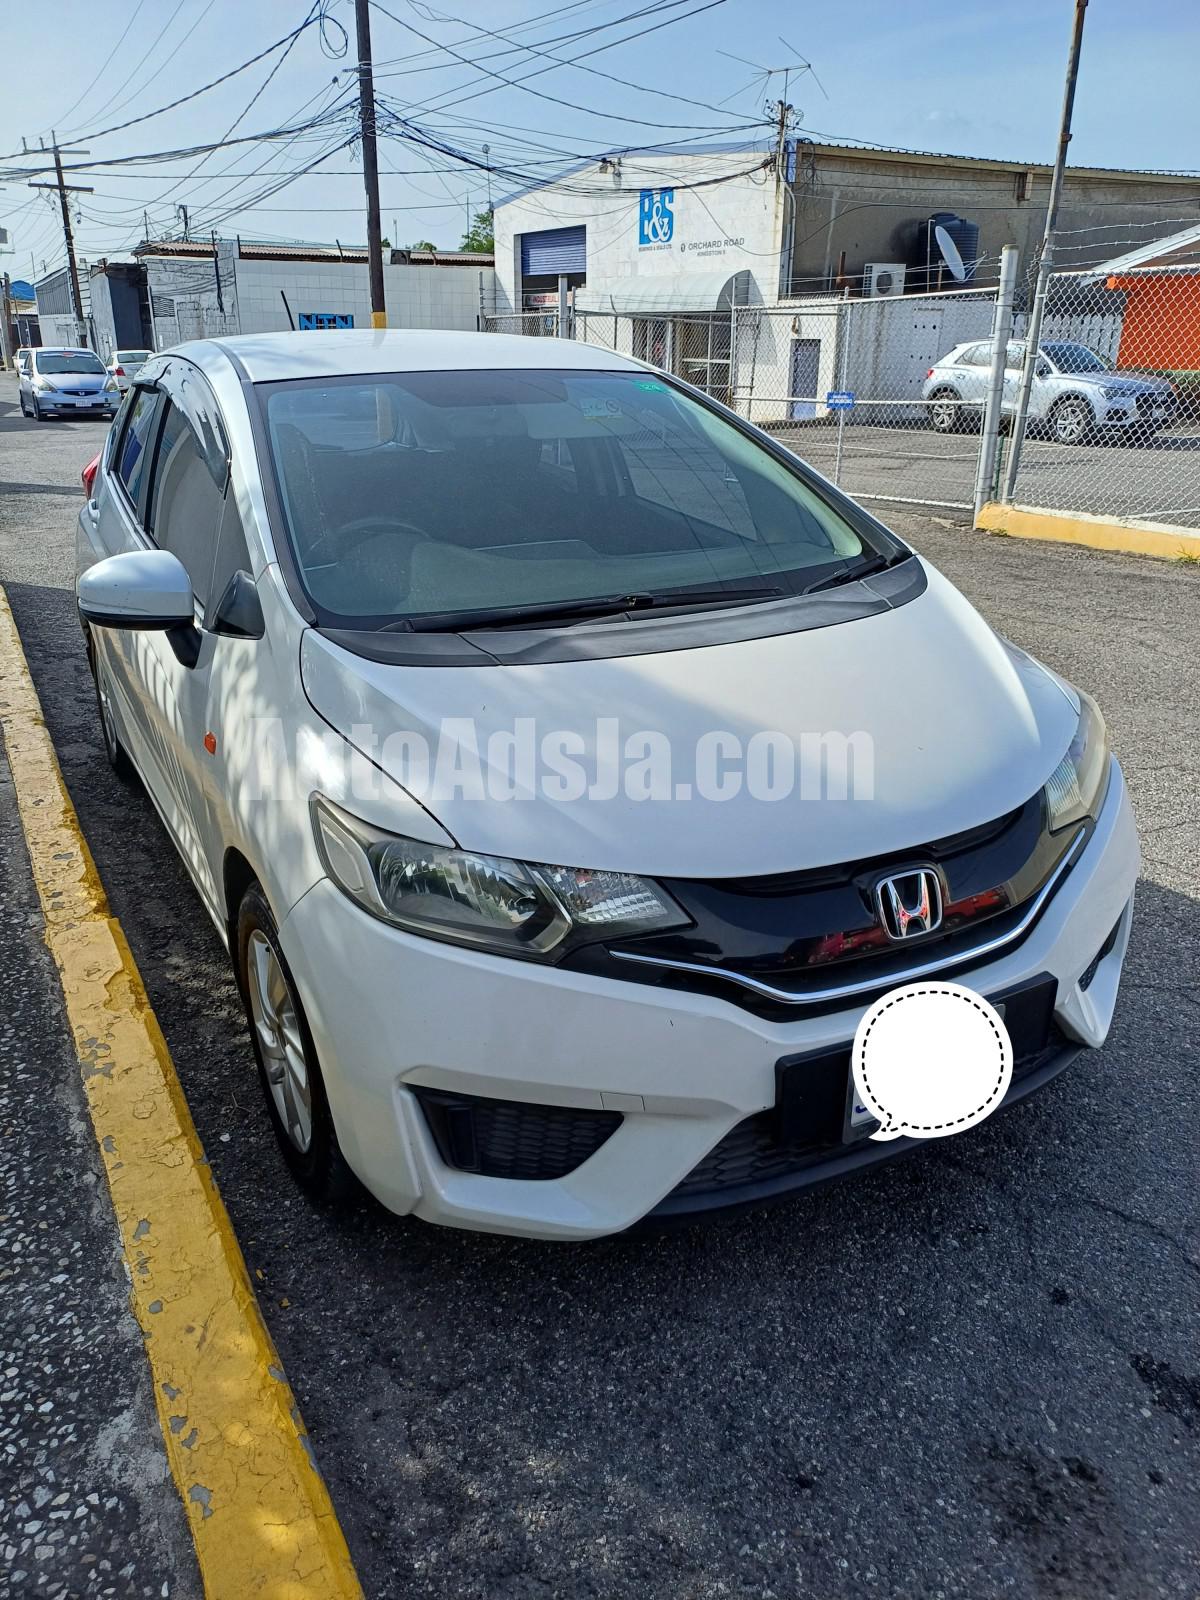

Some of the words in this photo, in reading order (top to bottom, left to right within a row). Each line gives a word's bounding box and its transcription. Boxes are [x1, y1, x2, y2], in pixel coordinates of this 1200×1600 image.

[687, 240, 722, 251] ORCHARD
[723, 237, 745, 247] ROAD
[299, 313, 353, 330] NTN
